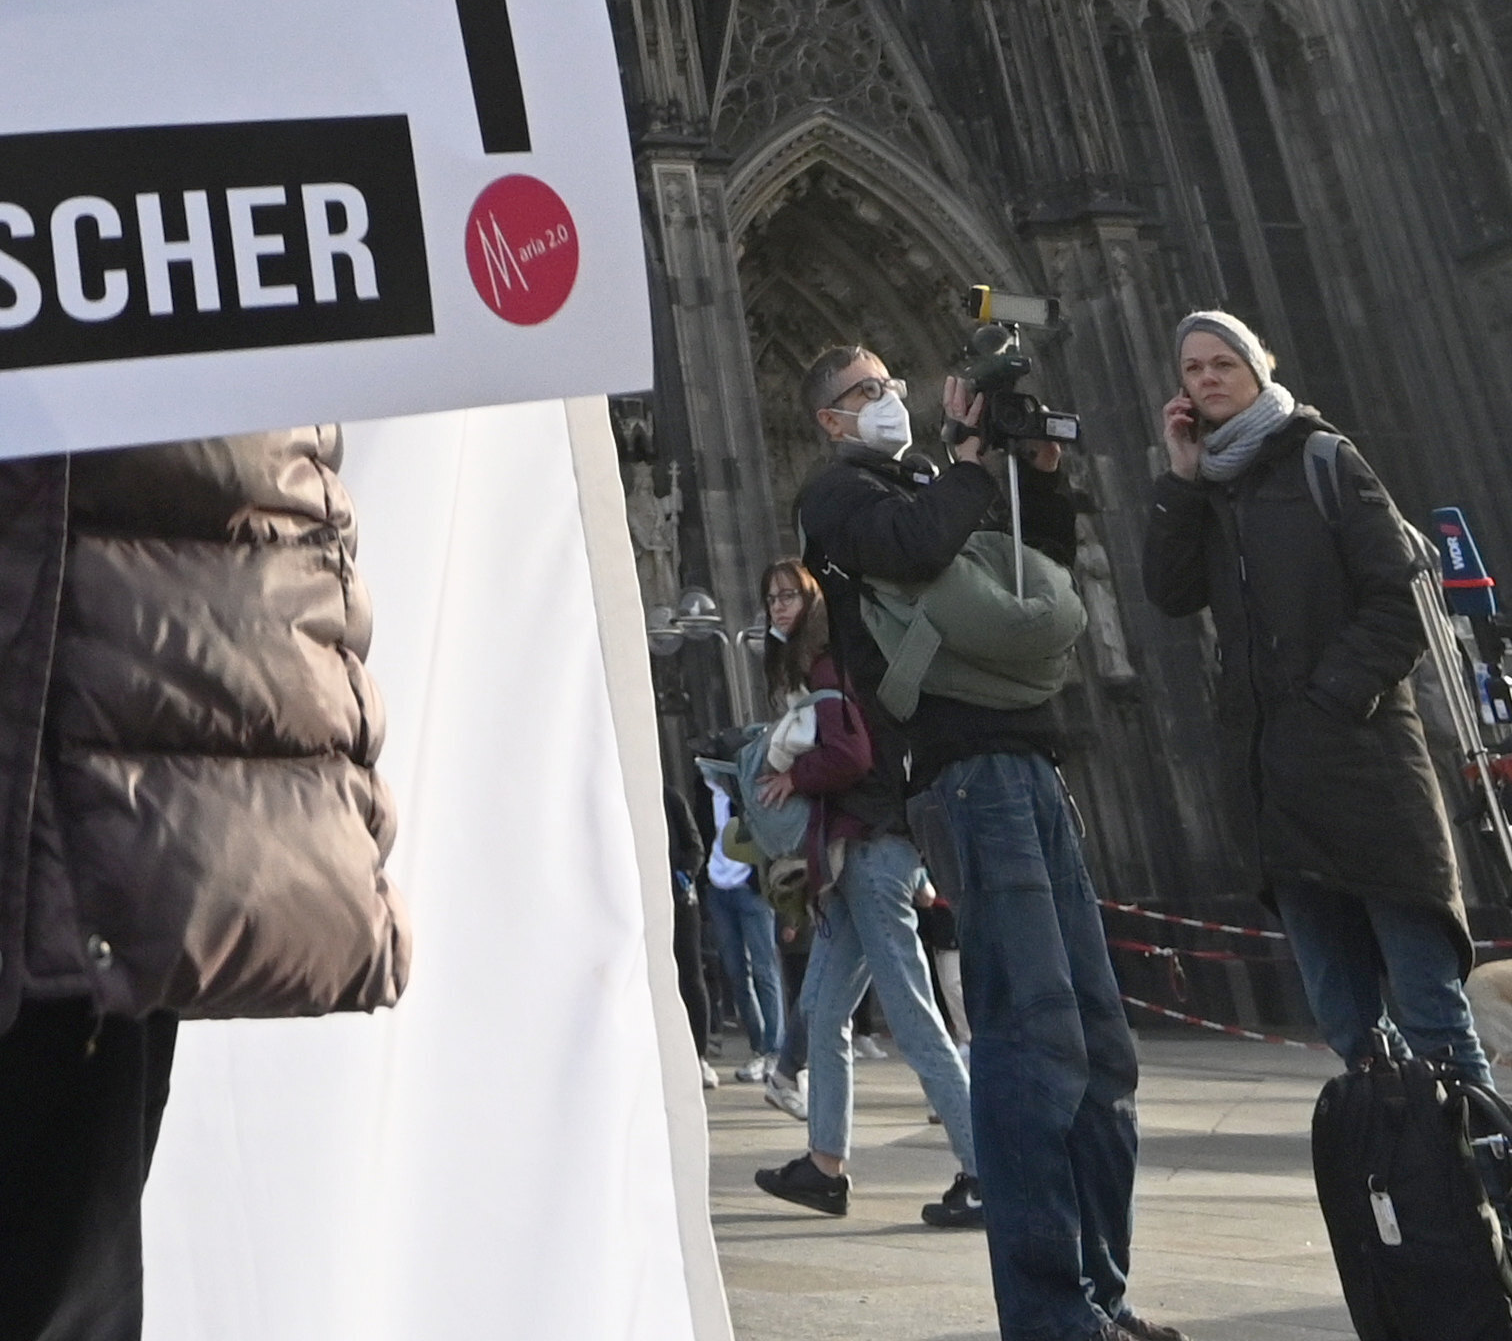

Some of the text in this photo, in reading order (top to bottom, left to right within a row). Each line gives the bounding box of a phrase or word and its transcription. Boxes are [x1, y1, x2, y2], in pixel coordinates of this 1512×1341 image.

[475, 209, 569, 310] Maria 2.0
[1446, 536, 1466, 571] WDR
